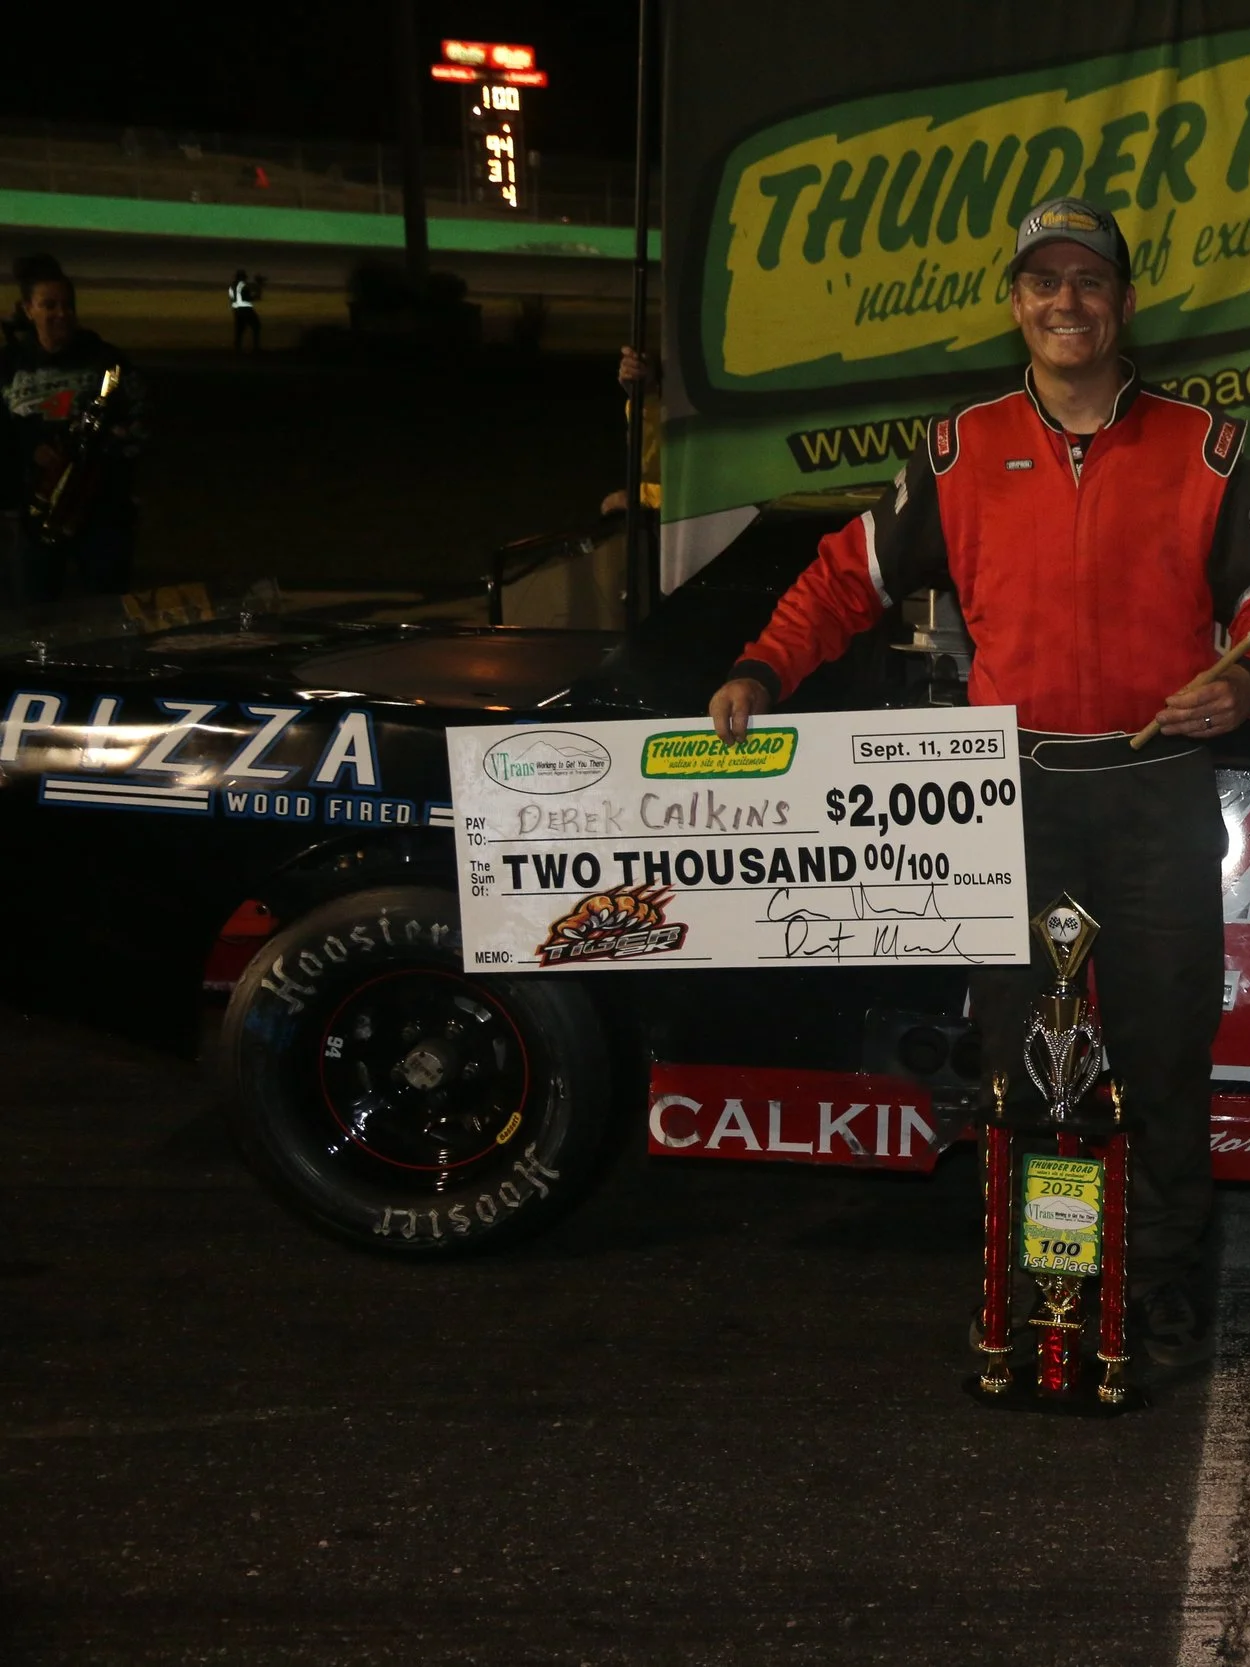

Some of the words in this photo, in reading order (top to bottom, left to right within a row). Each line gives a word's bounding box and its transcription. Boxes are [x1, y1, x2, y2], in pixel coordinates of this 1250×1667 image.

[482, 85, 521, 111] 100
[486, 134, 514, 159] 94
[487, 159, 516, 182] 31
[756, 101, 1208, 270] THUNDER
[1, 690, 378, 788] PIZZA
[652, 739, 730, 758] THUNDER
[735, 737, 785, 755] ROAD
[860, 742, 911, 760] Sept.
[918, 741, 942, 758] 11,
[949, 738, 999, 754] 2025
[490, 752, 535, 781] VTrans
[227, 791, 311, 818] WOOD
[329, 799, 412, 825] FIRED
[517, 800, 625, 836] DEREK
[826, 778, 1016, 837] $2,000.00
[465, 817, 486, 831] PAY
[467, 833, 487, 846] TO:
[469, 860, 491, 872] The
[502, 851, 600, 890] TWO
[613, 845, 857, 887] THOUSAND
[470, 873, 495, 885] Sum
[953, 873, 1012, 885] DOLLARS
[471, 885, 489, 897] Of:
[543, 926, 682, 960] TIGER
[475, 951, 513, 964] MEMO:
[324, 1034, 346, 1060] 94
[1031, 1160, 1070, 1172] THUNDER
[1070, 1164, 1094, 1174] ROAD
[1040, 1181, 1085, 1198] 2025
[1040, 1240, 1081, 1257] 100
[1022, 1252, 1048, 1269] 1st
[1052, 1256, 1098, 1275] Place
